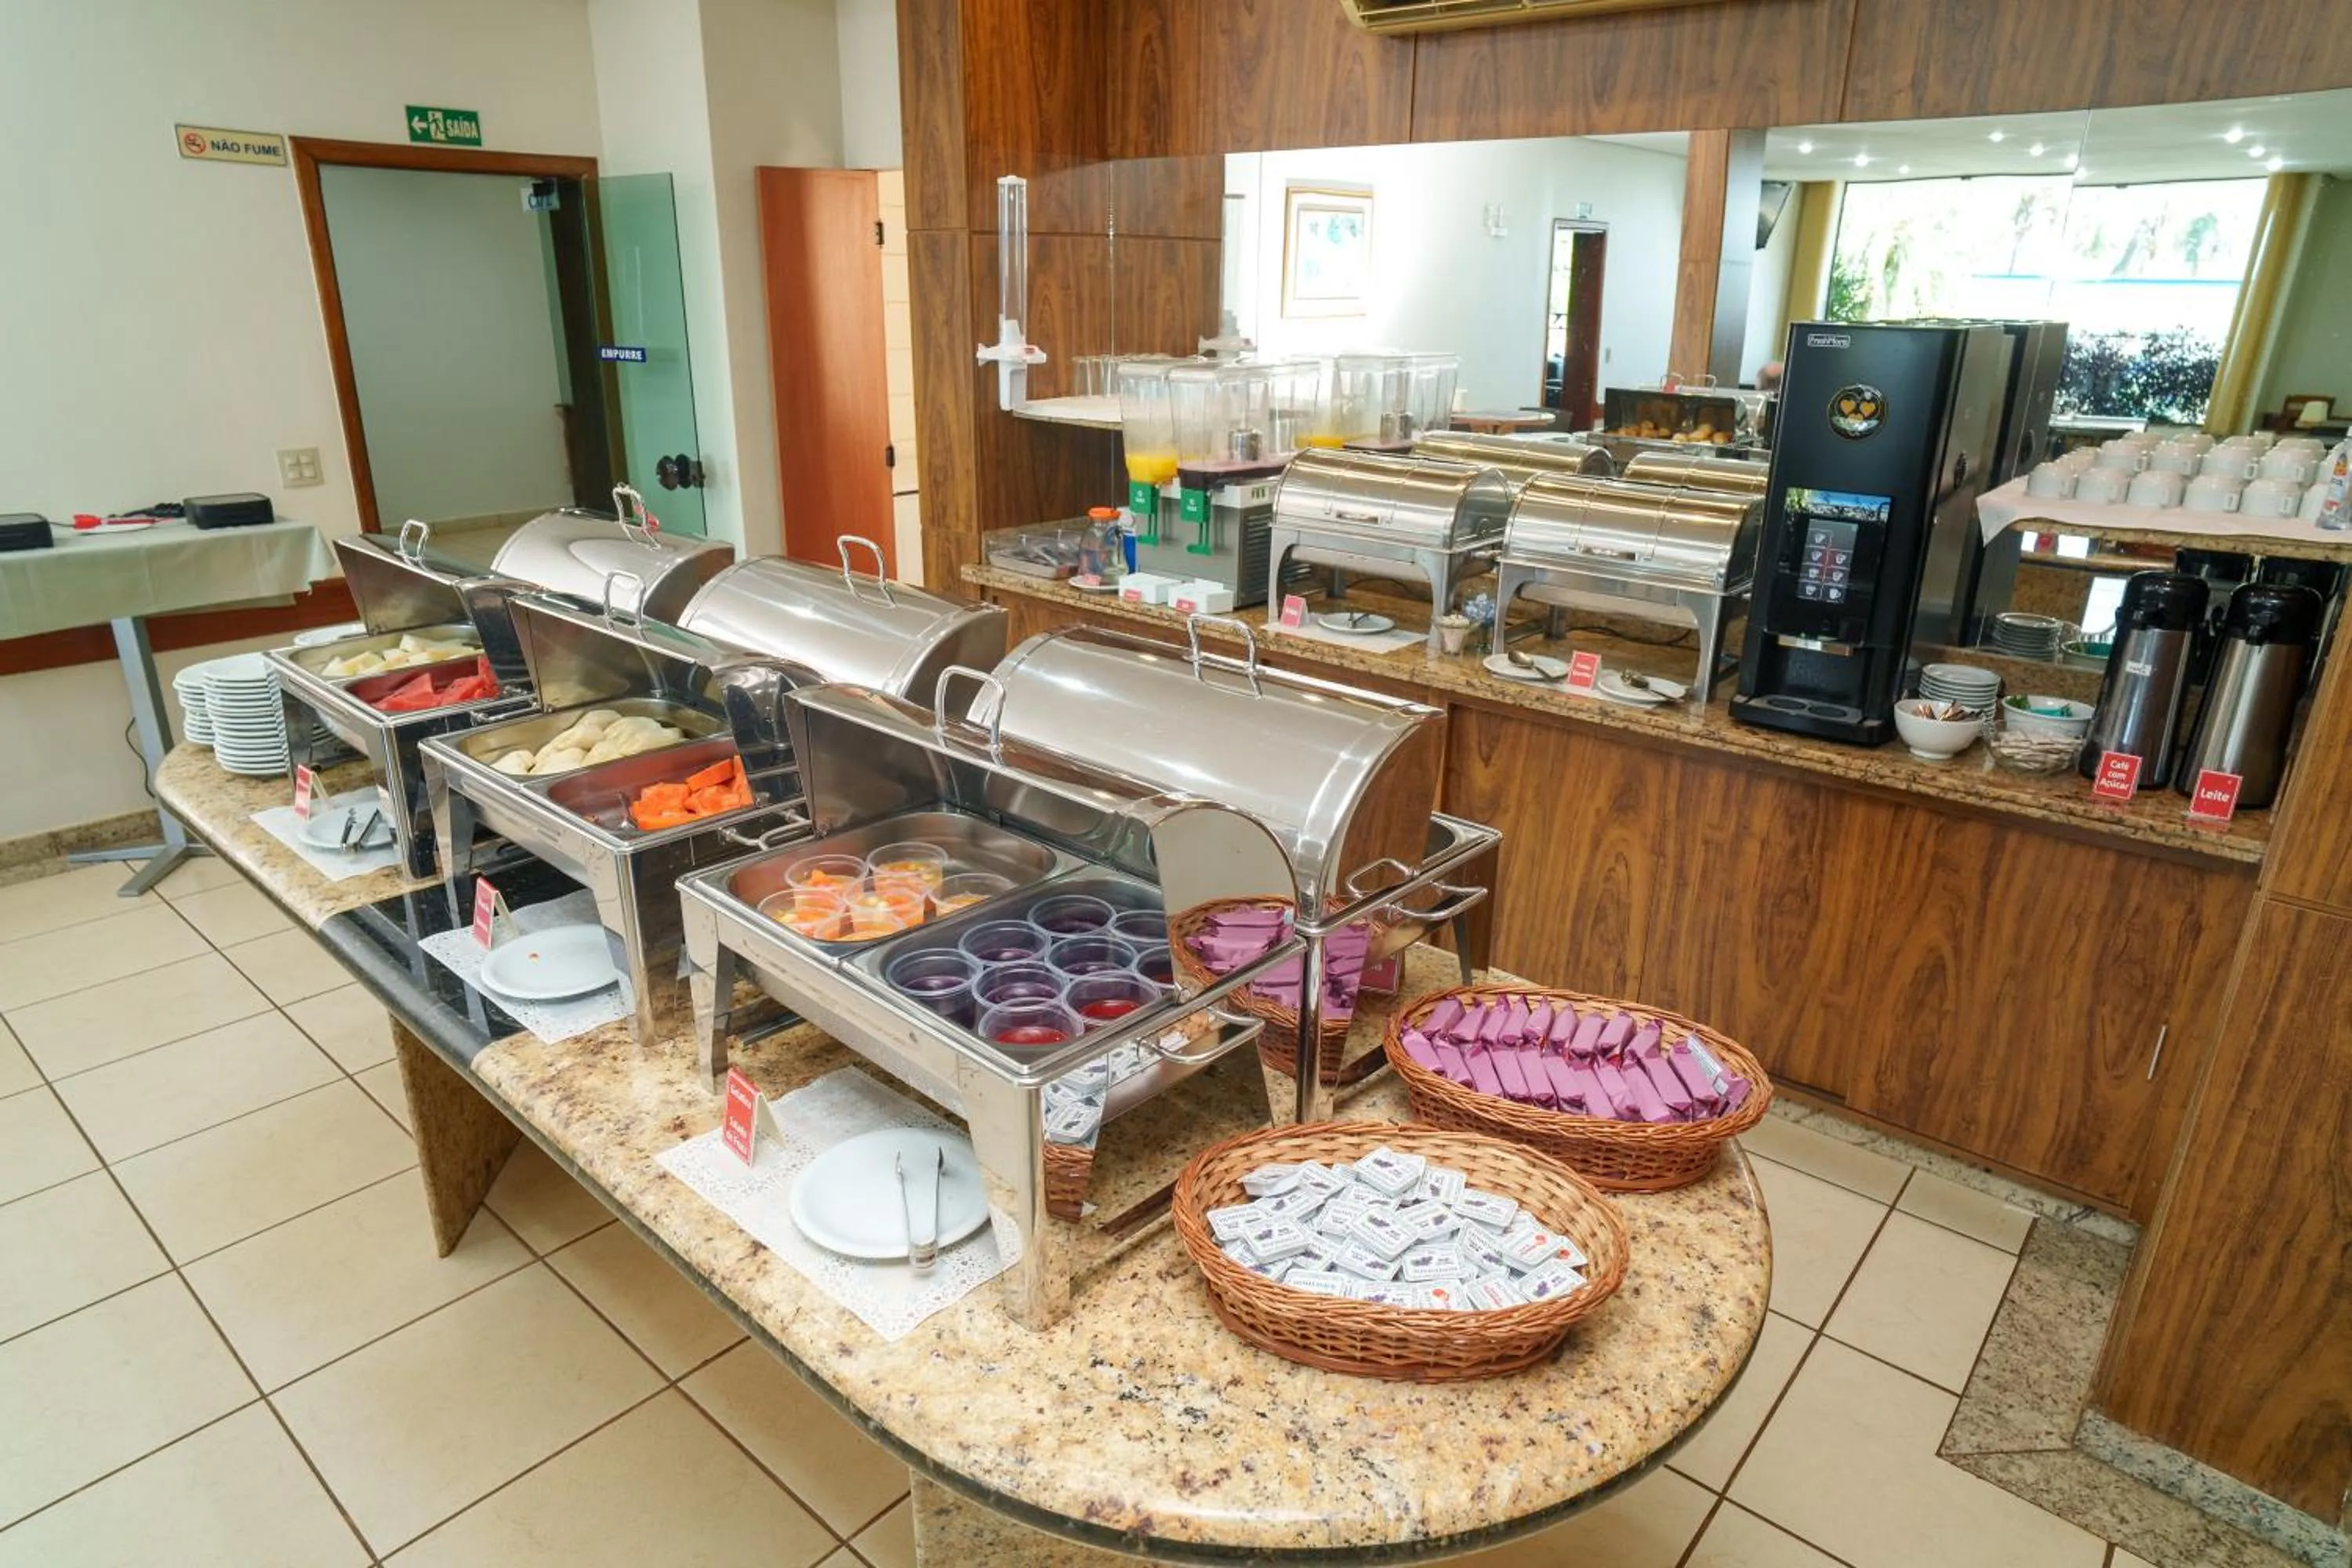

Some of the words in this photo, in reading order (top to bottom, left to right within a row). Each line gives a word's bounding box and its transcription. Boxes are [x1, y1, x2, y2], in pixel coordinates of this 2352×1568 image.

[446, 115, 479, 139] SAÍDA
[210, 138, 241, 154] NÃO
[244, 143, 281, 156] FUME
[601, 347, 643, 360] EMPURRE
[2201, 787, 2230, 802] Leite
